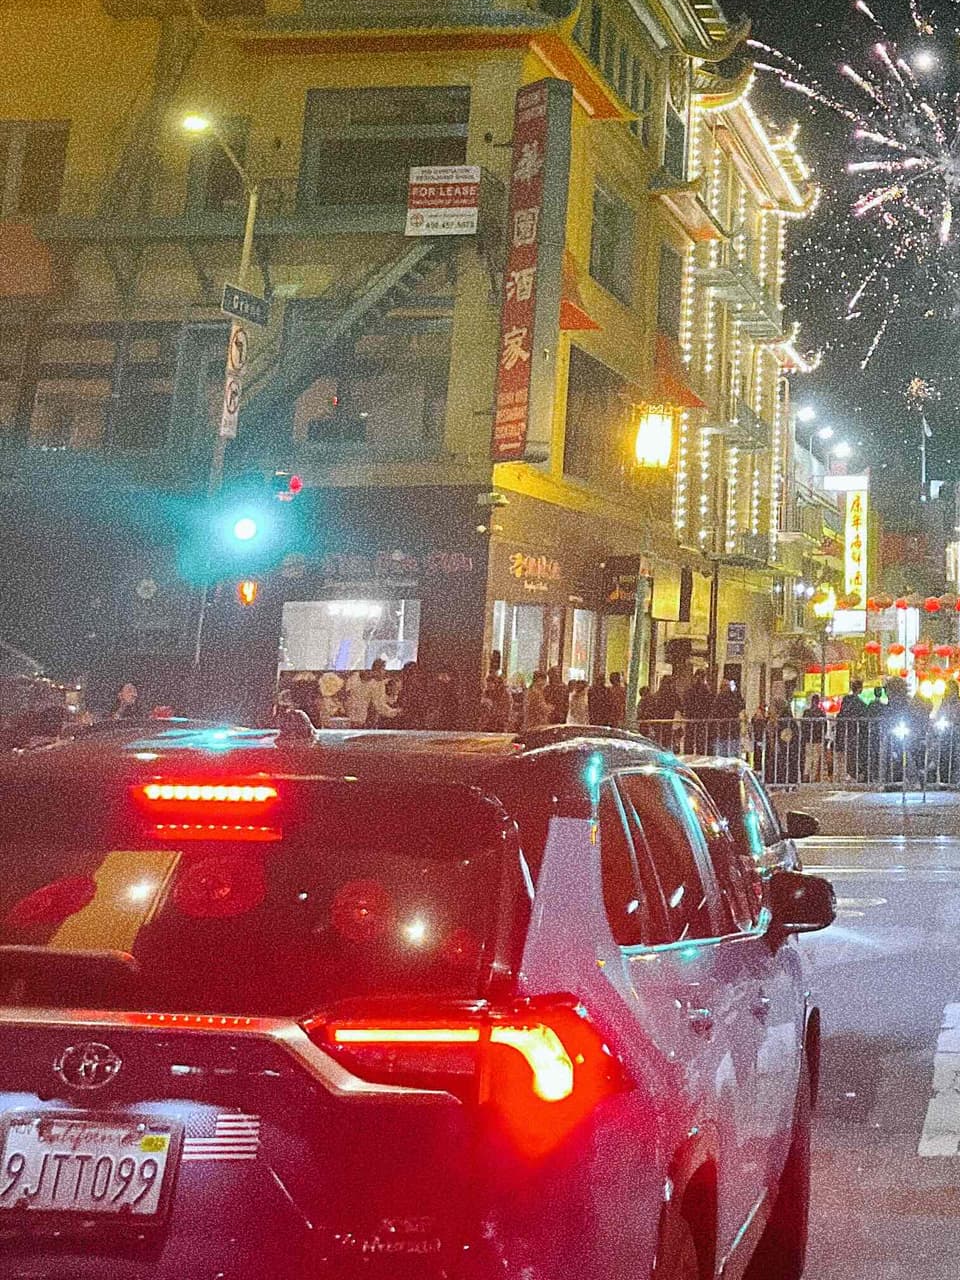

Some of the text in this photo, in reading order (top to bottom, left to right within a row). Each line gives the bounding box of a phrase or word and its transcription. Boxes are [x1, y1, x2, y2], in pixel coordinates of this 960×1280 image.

[412, 186, 477, 197] FOR LEASE
[0, 1152, 158, 1206] 9JTT099
